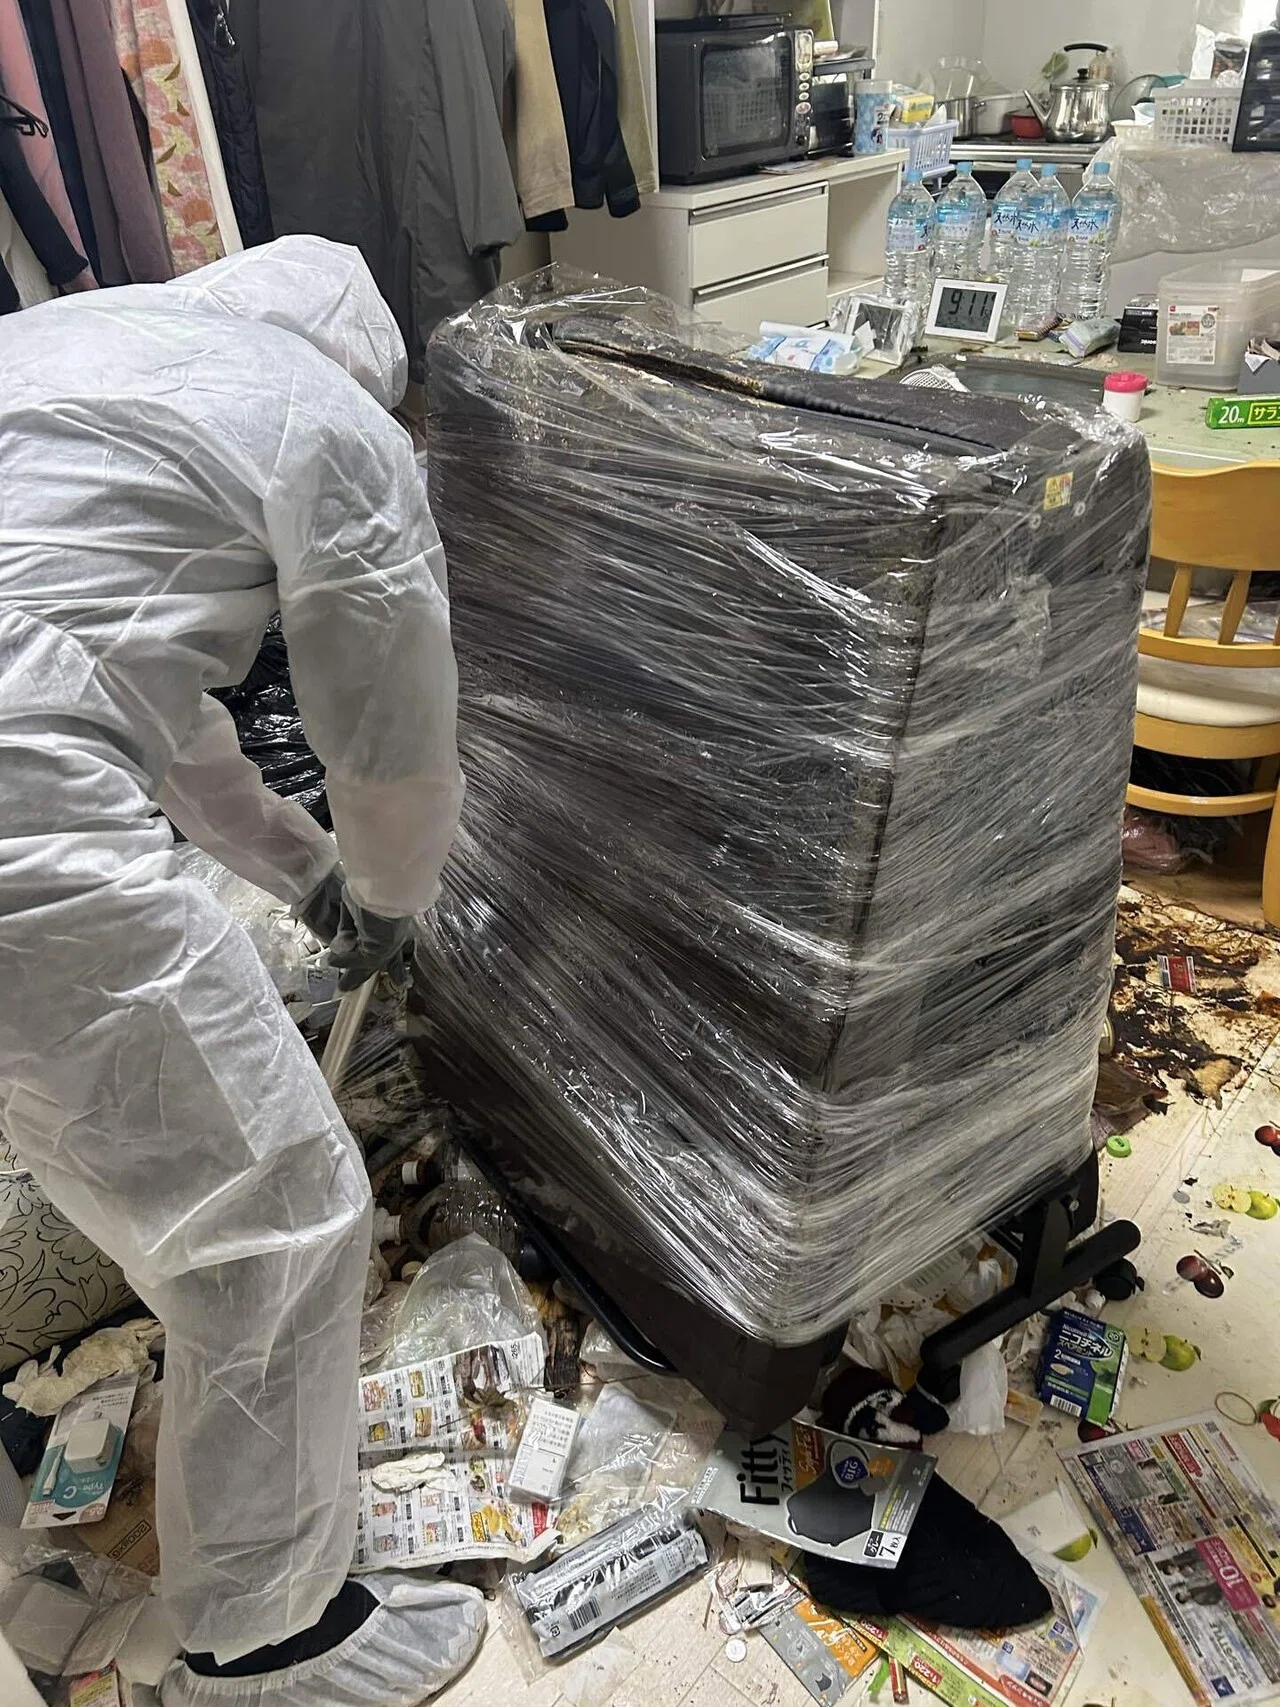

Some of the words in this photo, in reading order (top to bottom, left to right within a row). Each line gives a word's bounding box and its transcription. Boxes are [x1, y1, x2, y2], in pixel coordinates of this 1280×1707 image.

[1070, 218, 1099, 232] 天然水
[1058, 1329, 1113, 1357] ニコチネル
[736, 1432, 790, 1506] Fitty
[844, 1457, 859, 1481] BIG
